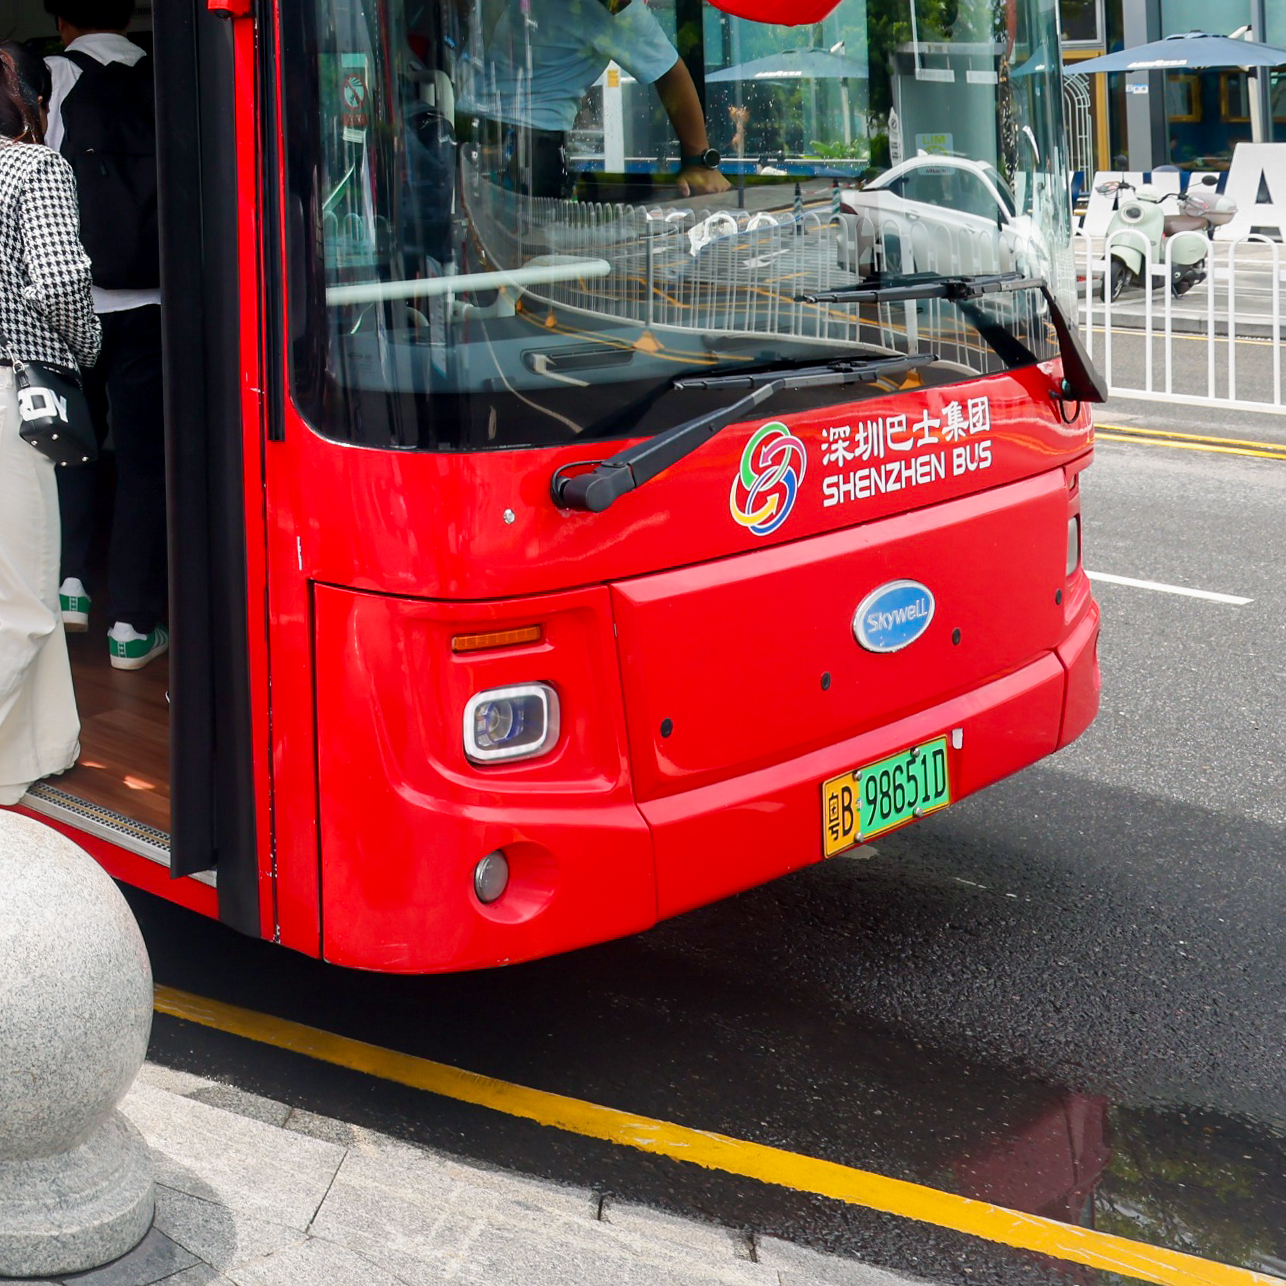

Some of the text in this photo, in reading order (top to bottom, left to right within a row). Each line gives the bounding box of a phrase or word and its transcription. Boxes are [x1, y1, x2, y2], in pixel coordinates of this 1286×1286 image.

[821, 395, 991, 467] 深圳巴士集团
[822, 440, 992, 507] SHENZHEN BUS
[865, 748, 947, 827] 98651D
